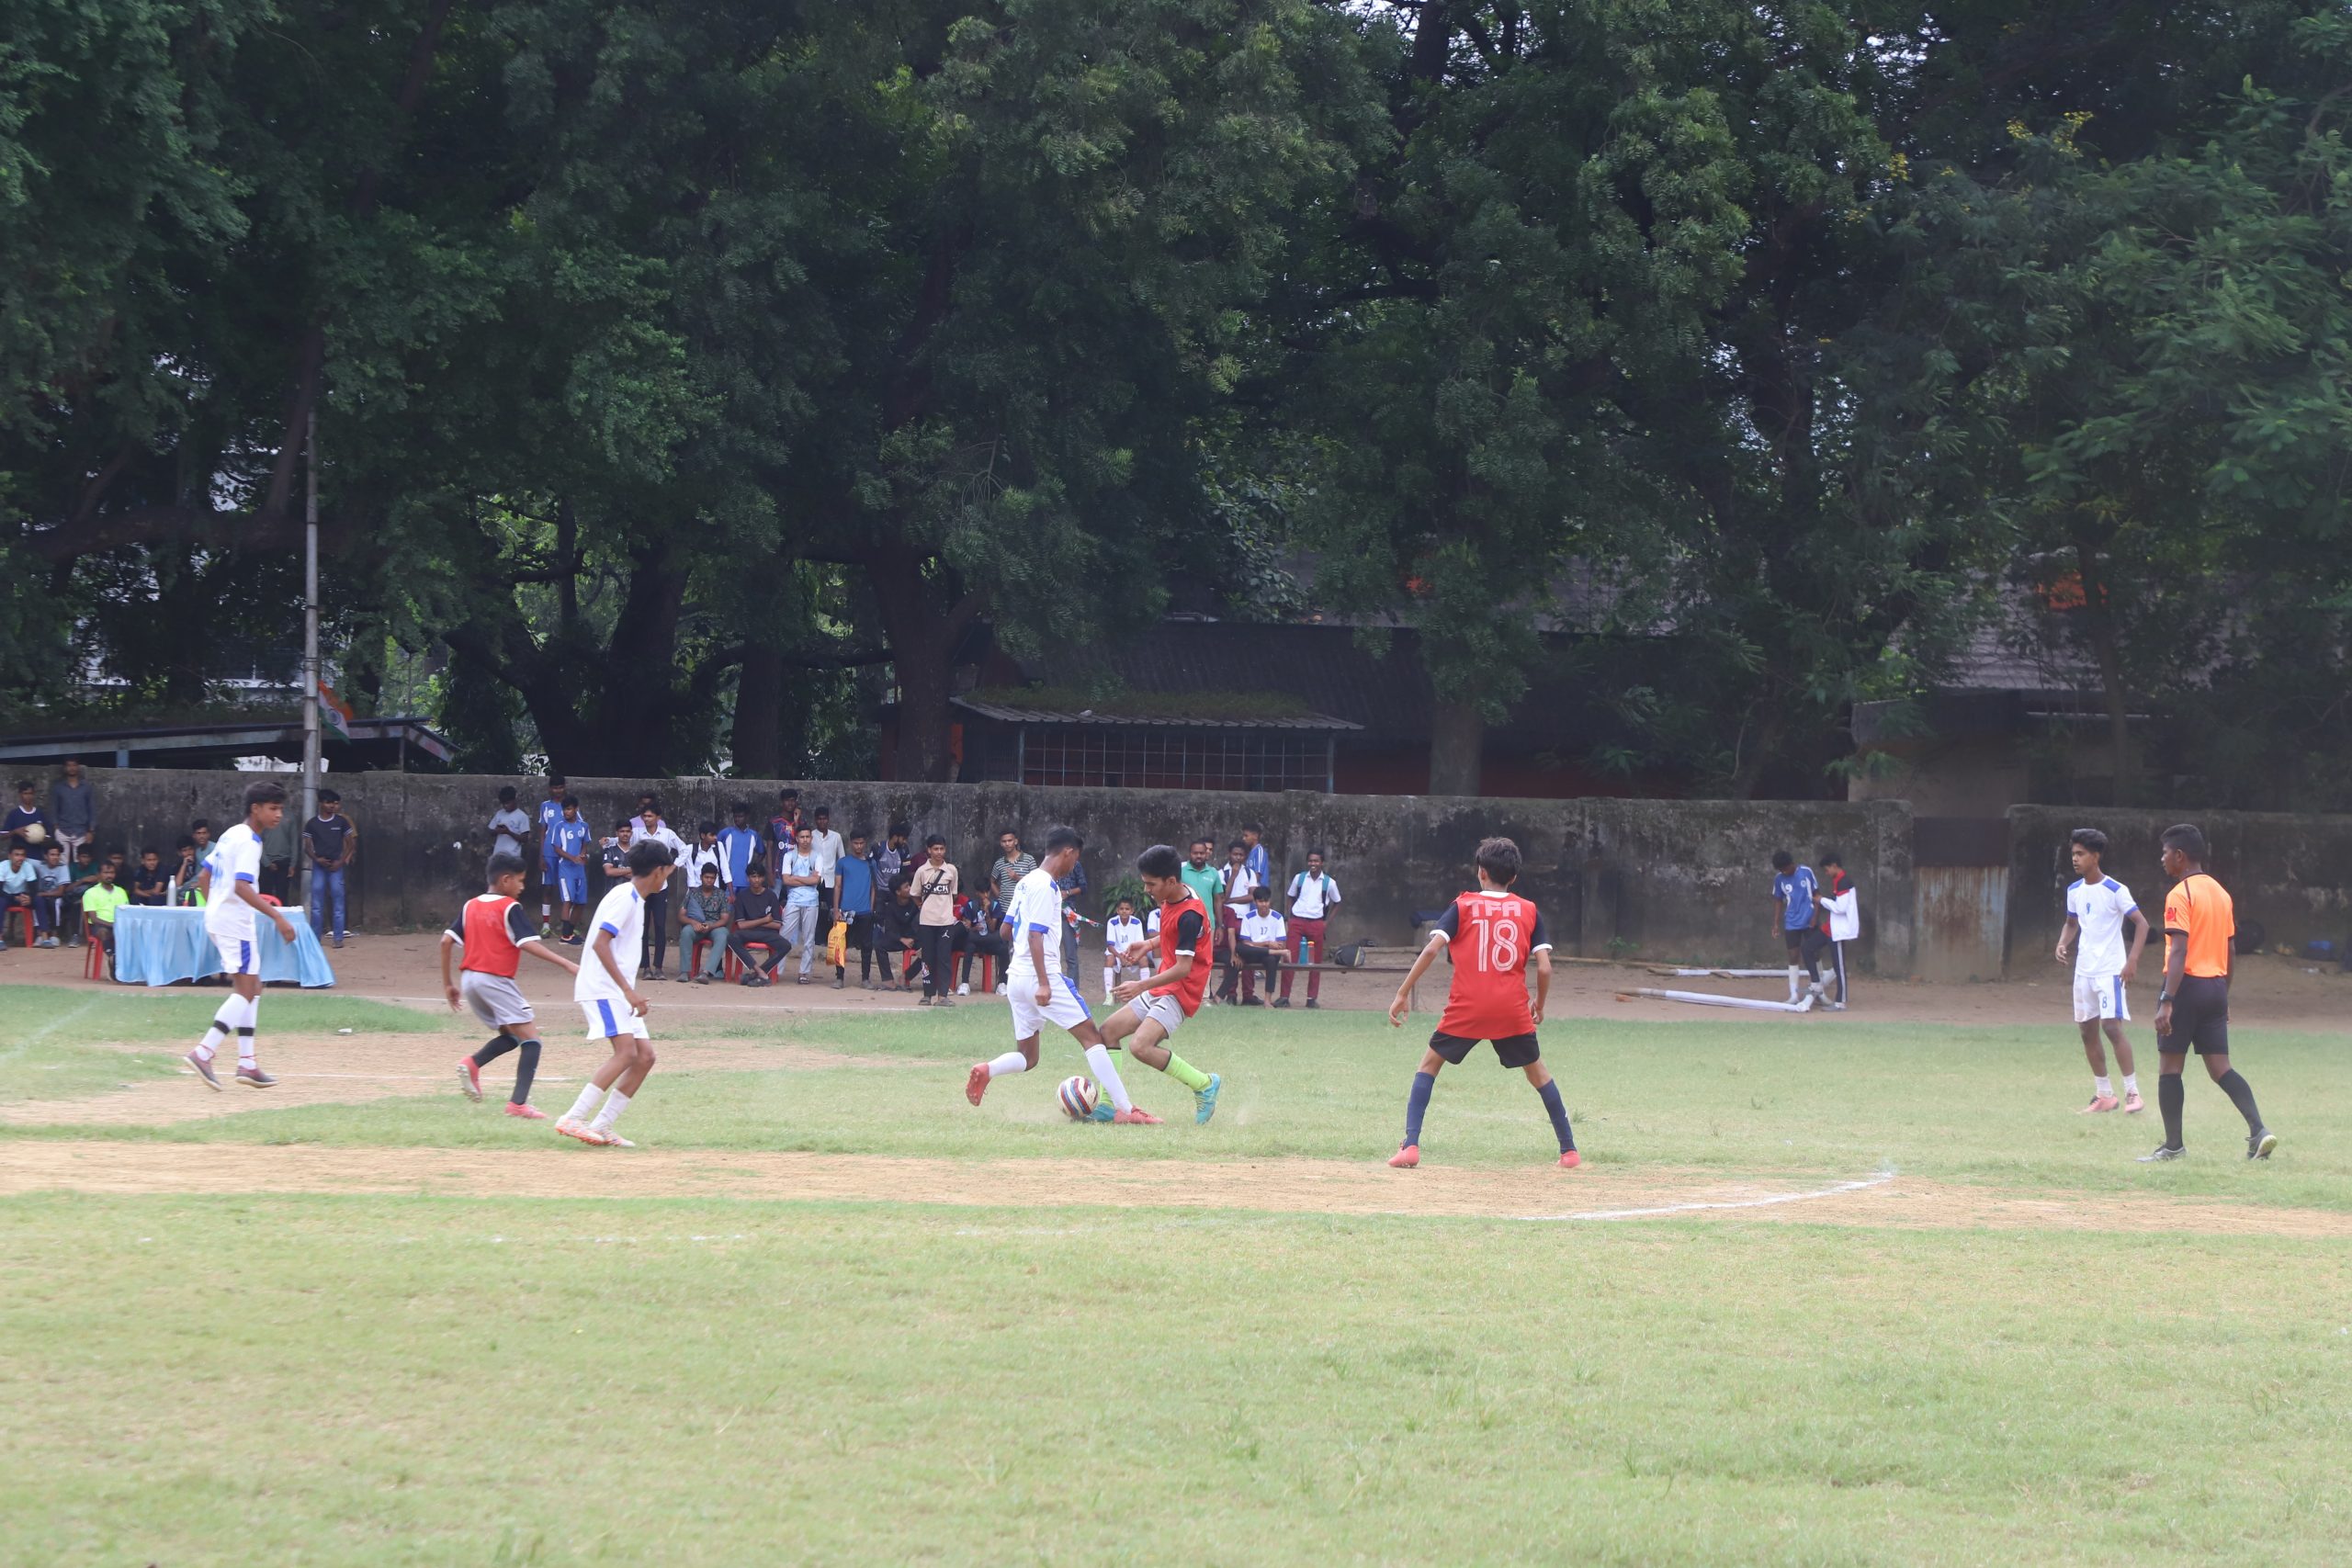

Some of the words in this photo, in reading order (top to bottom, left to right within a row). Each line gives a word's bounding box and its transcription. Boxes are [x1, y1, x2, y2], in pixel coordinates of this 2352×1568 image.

[567, 830, 574, 840] 6
[1785, 884, 1792, 893] 9
[1465, 900, 1521, 917] TFA
[1471, 919, 1519, 972] 18
[2102, 996, 2108, 1009] 8
